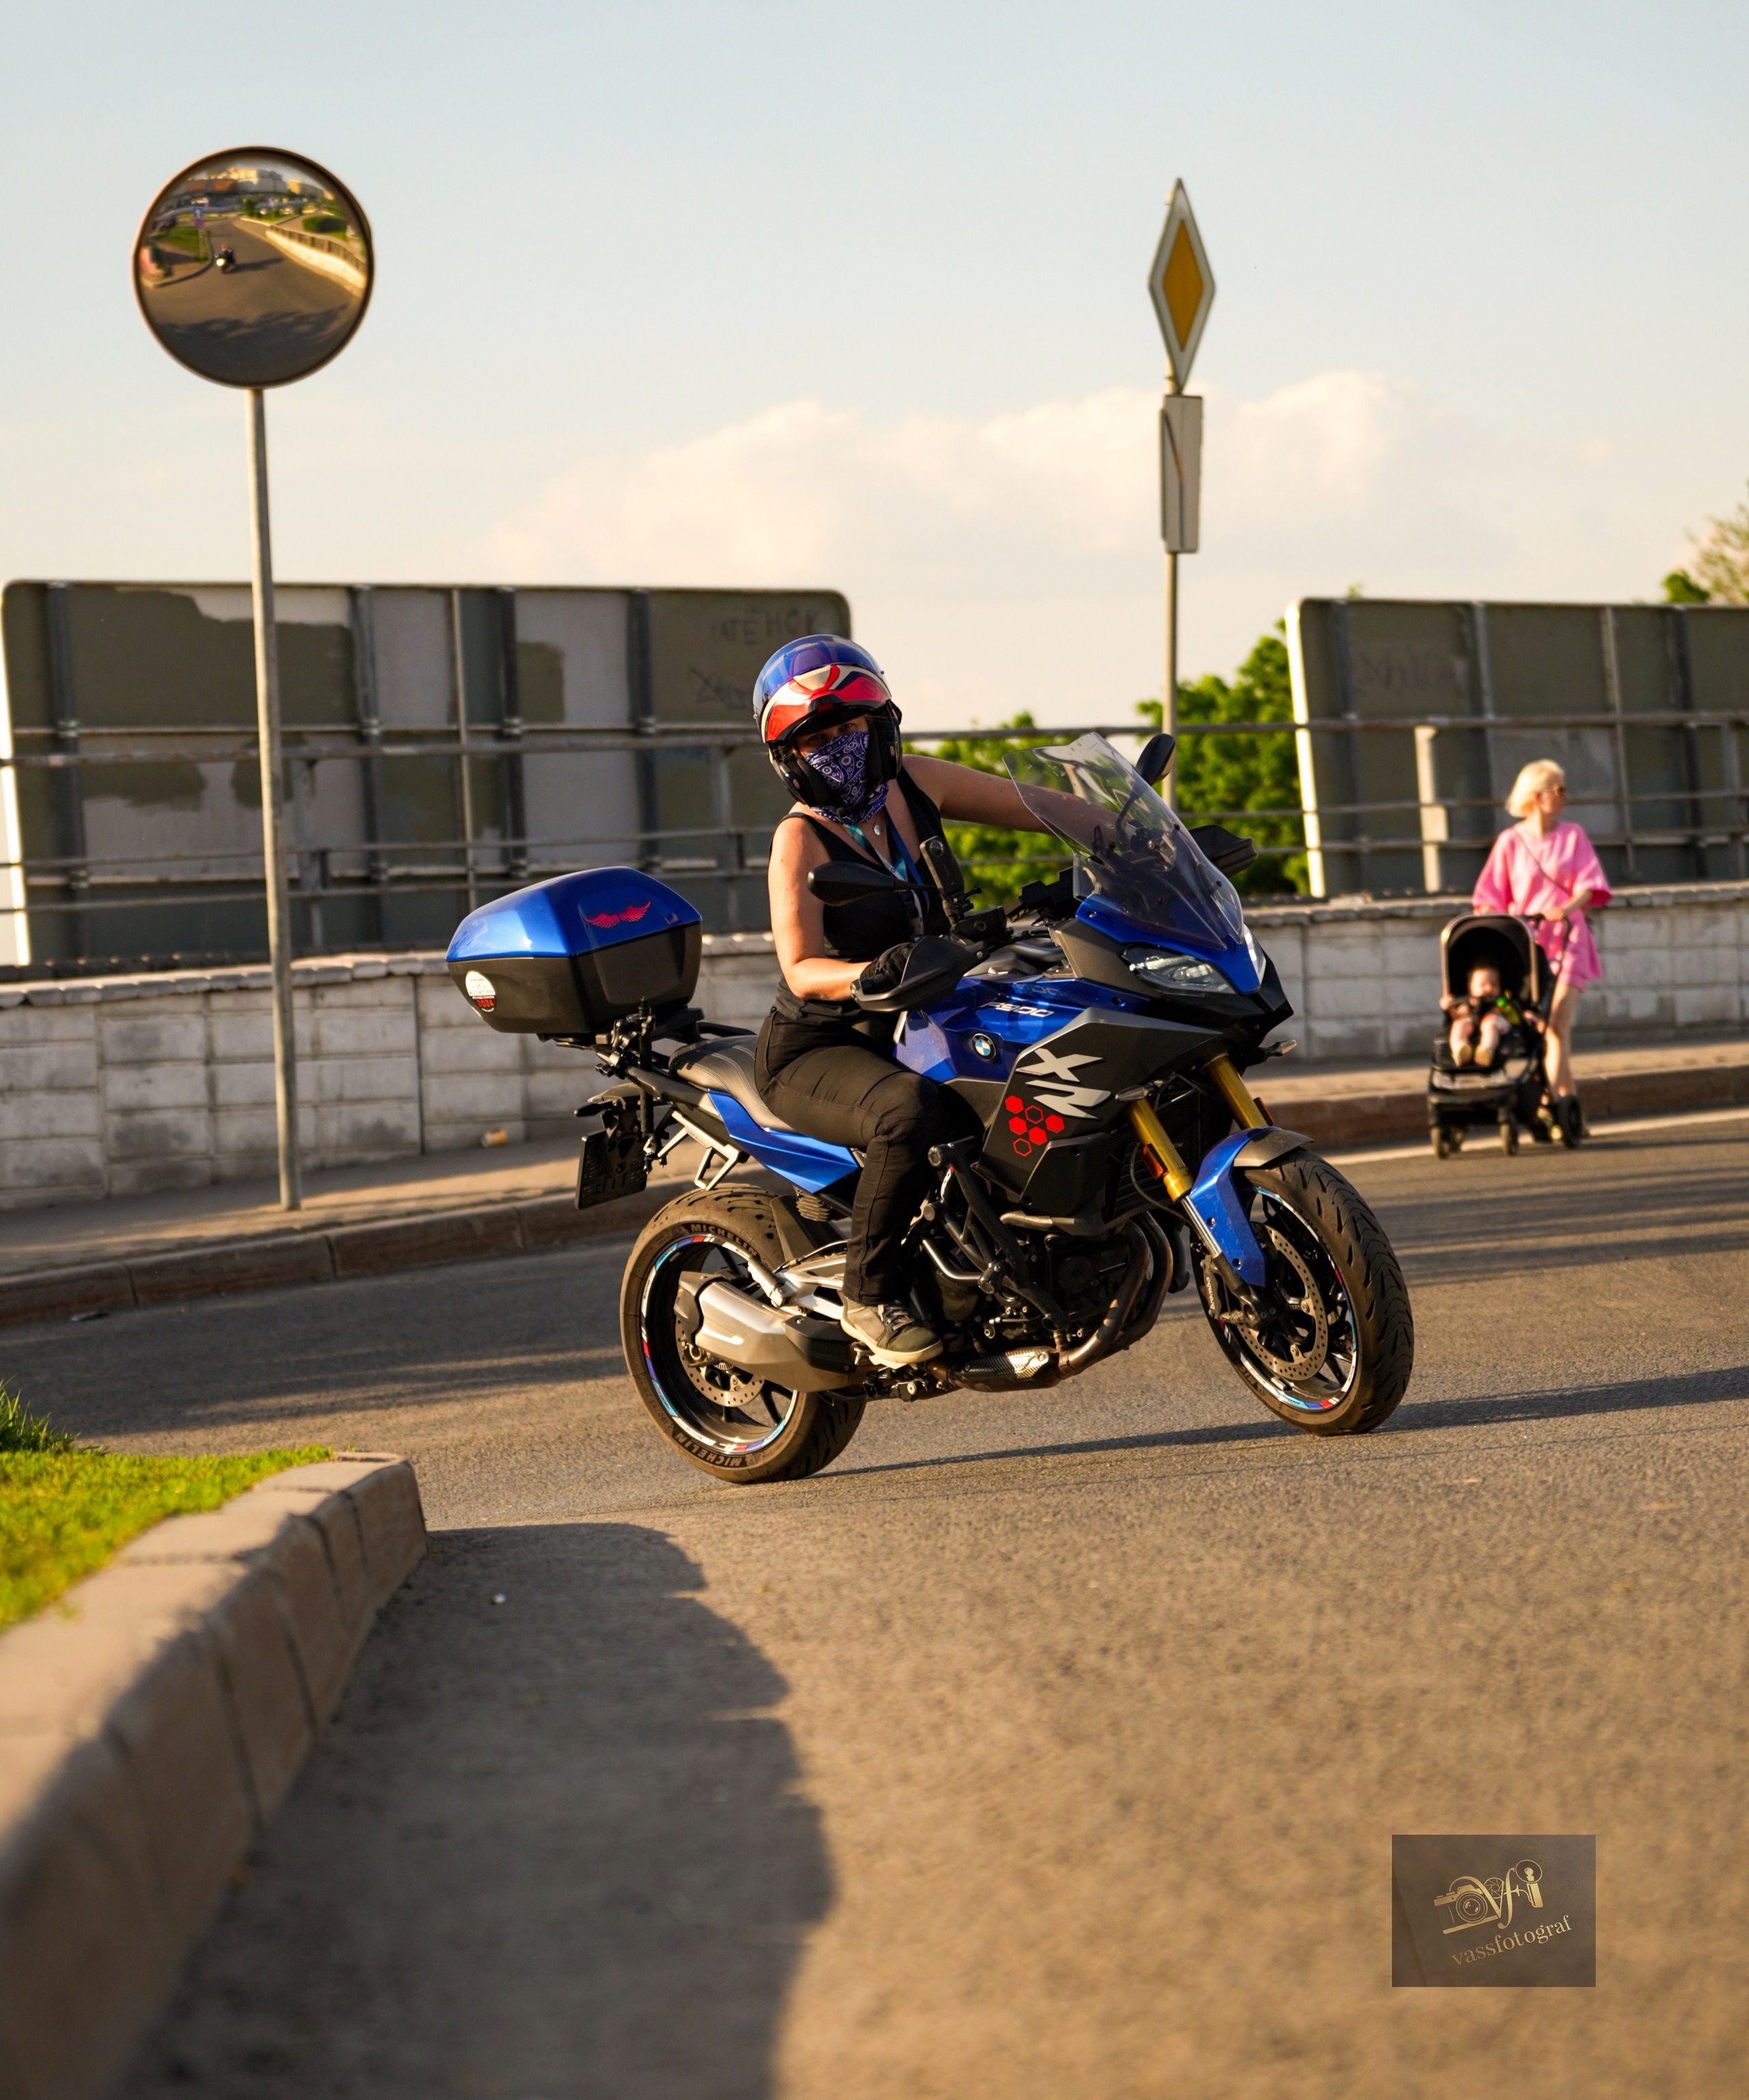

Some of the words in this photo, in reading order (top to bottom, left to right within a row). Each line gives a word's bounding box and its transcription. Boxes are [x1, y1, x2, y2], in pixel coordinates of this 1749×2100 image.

[690, 1224, 758, 1258] MICHELIN
[1206, 1277, 1215, 1310] brembo
[675, 1433, 743, 1467] MICHELIN
